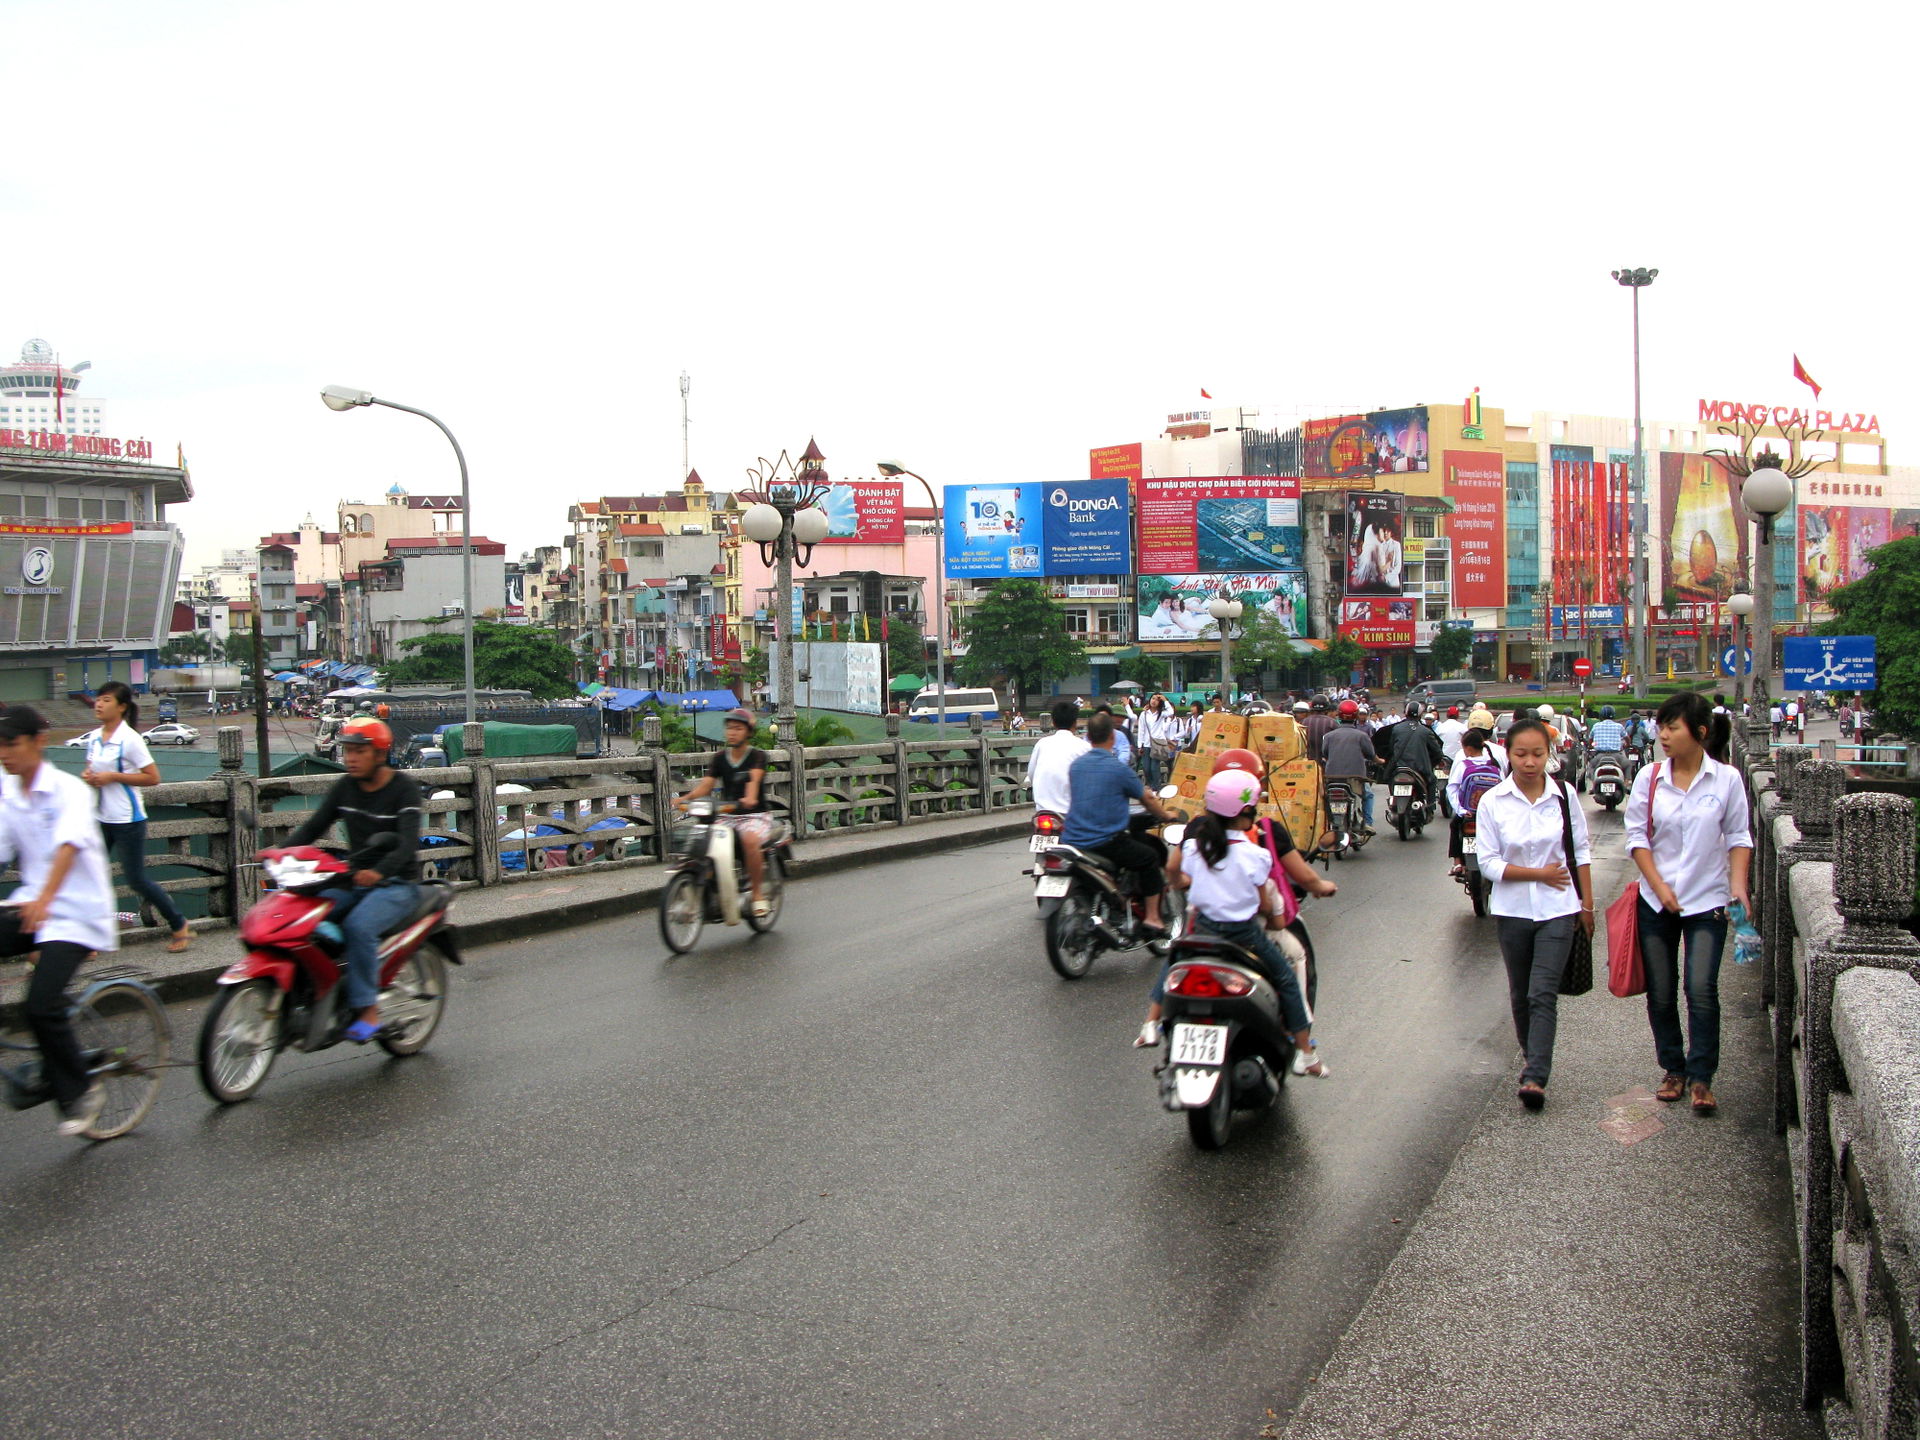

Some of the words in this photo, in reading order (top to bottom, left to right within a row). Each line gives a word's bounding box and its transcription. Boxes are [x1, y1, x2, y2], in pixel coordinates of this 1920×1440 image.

[1699, 399, 1768, 424] MONG
[1773, 406, 1809, 428] CAI
[1816, 410, 1880, 433] PLAZA
[28, 427, 66, 452] TÂM
[72, 431, 122, 457] MÓNG
[1147, 481, 1161, 489] KHU
[1180, 481, 1197, 489] DỊCH
[858, 488, 883, 497] ĐÁNH
[1069, 512, 1096, 523] Bank
[1255, 575, 1279, 592] Nội
[1364, 632, 1384, 642] KIM
[1386, 632, 1410, 642] SINH
